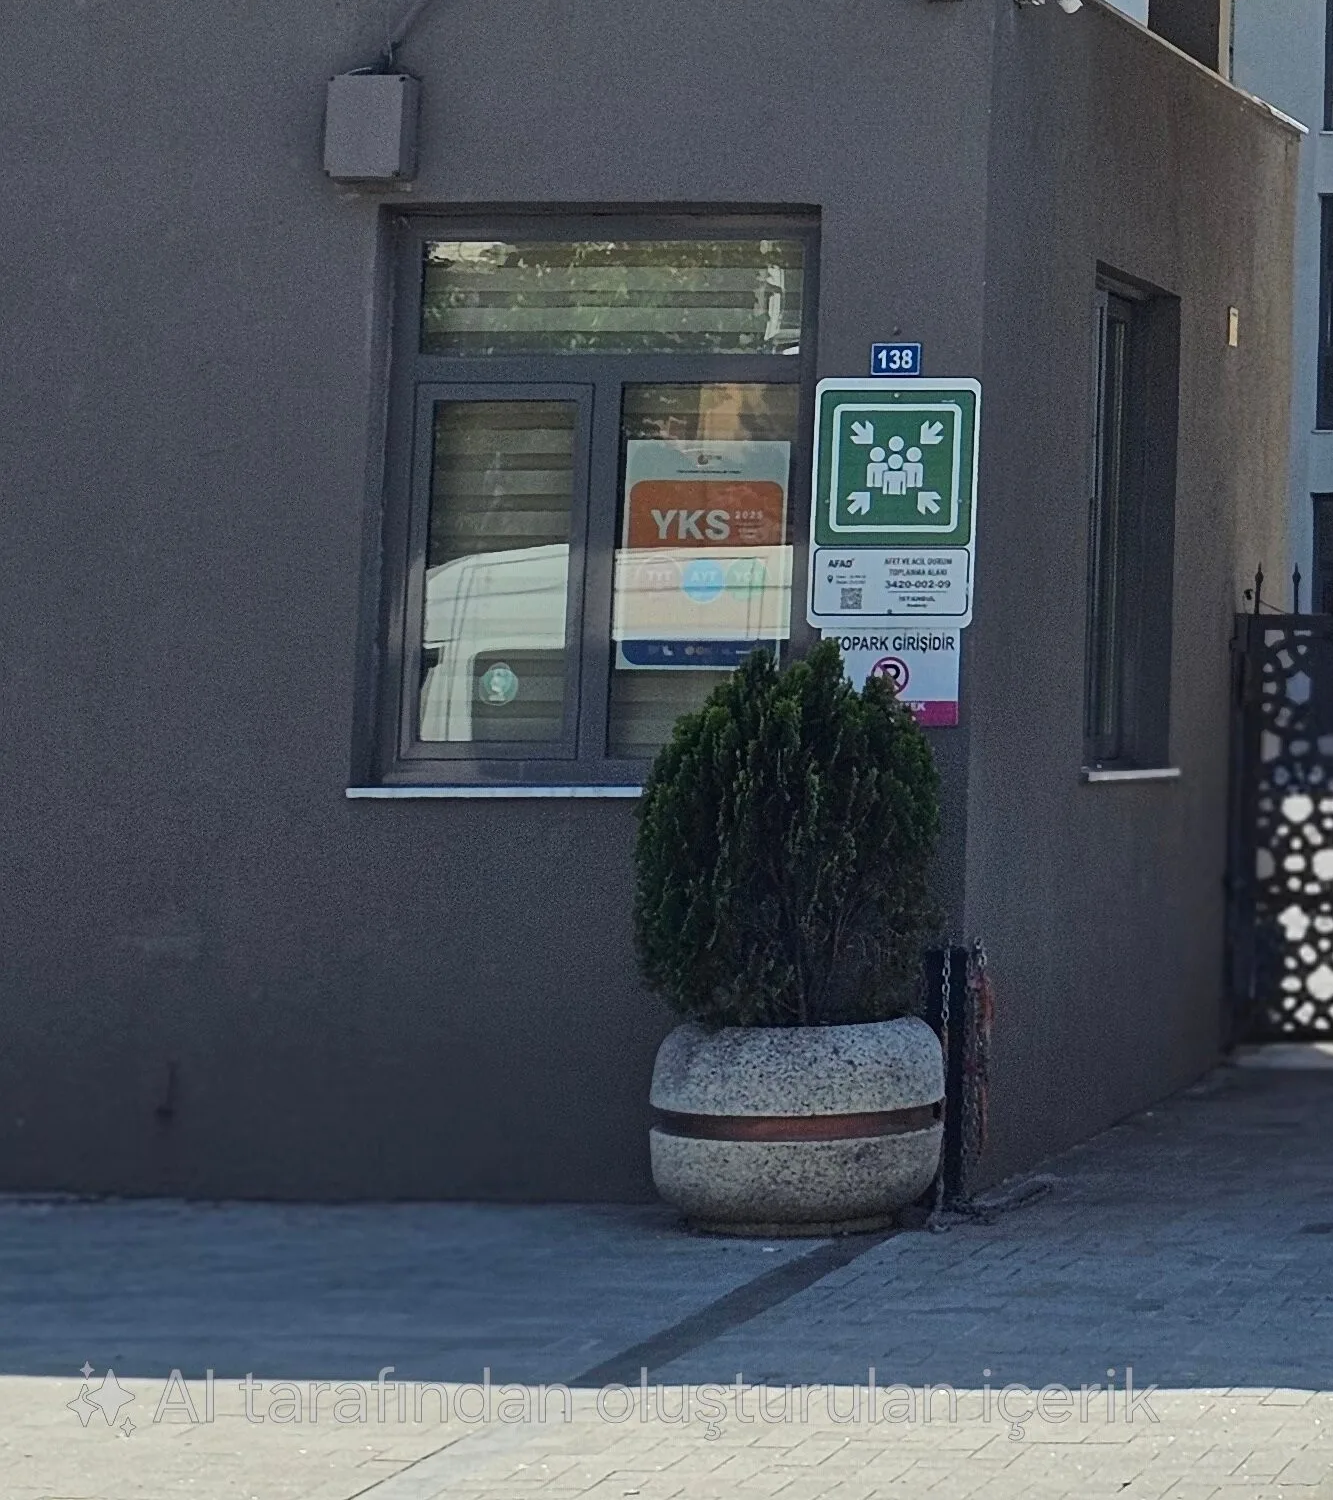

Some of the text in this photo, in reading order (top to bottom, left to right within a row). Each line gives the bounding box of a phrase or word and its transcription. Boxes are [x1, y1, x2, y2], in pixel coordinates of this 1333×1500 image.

[877, 349, 913, 370] 138
[651, 509, 731, 541] YKS
[828, 559, 853, 568] AFAD
[690, 570, 717, 582] AYT
[885, 579, 951, 588] 3420-002-09
[892, 632, 955, 653] GİRİŞİDİR
